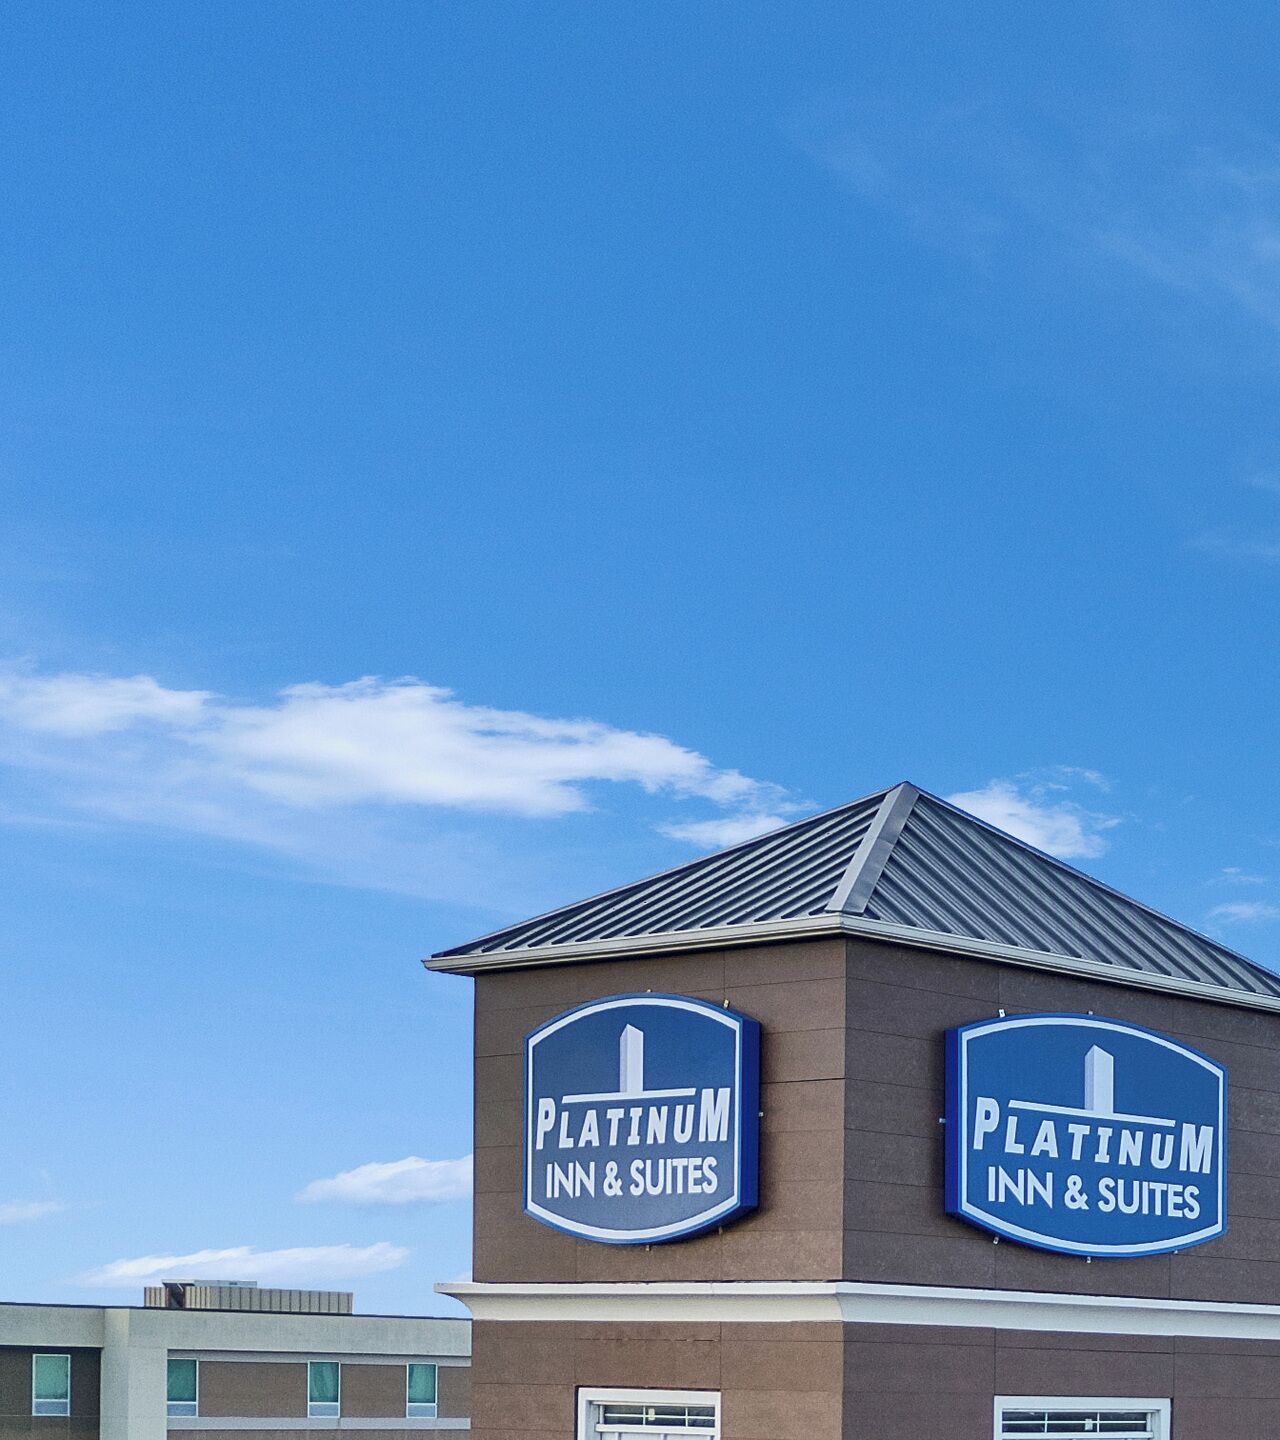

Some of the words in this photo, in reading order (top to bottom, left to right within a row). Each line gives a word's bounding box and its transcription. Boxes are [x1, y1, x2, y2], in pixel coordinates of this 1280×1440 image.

[536, 1087, 731, 1150] PLATINUM
[973, 1097, 1214, 1174] PLATINUM
[546, 1160, 595, 1198] INN
[603, 1161, 623, 1196] &
[629, 1156, 718, 1196] SUITES
[988, 1165, 1053, 1209] INN
[1064, 1175, 1089, 1210] &
[1098, 1177, 1201, 1220] SUITES
